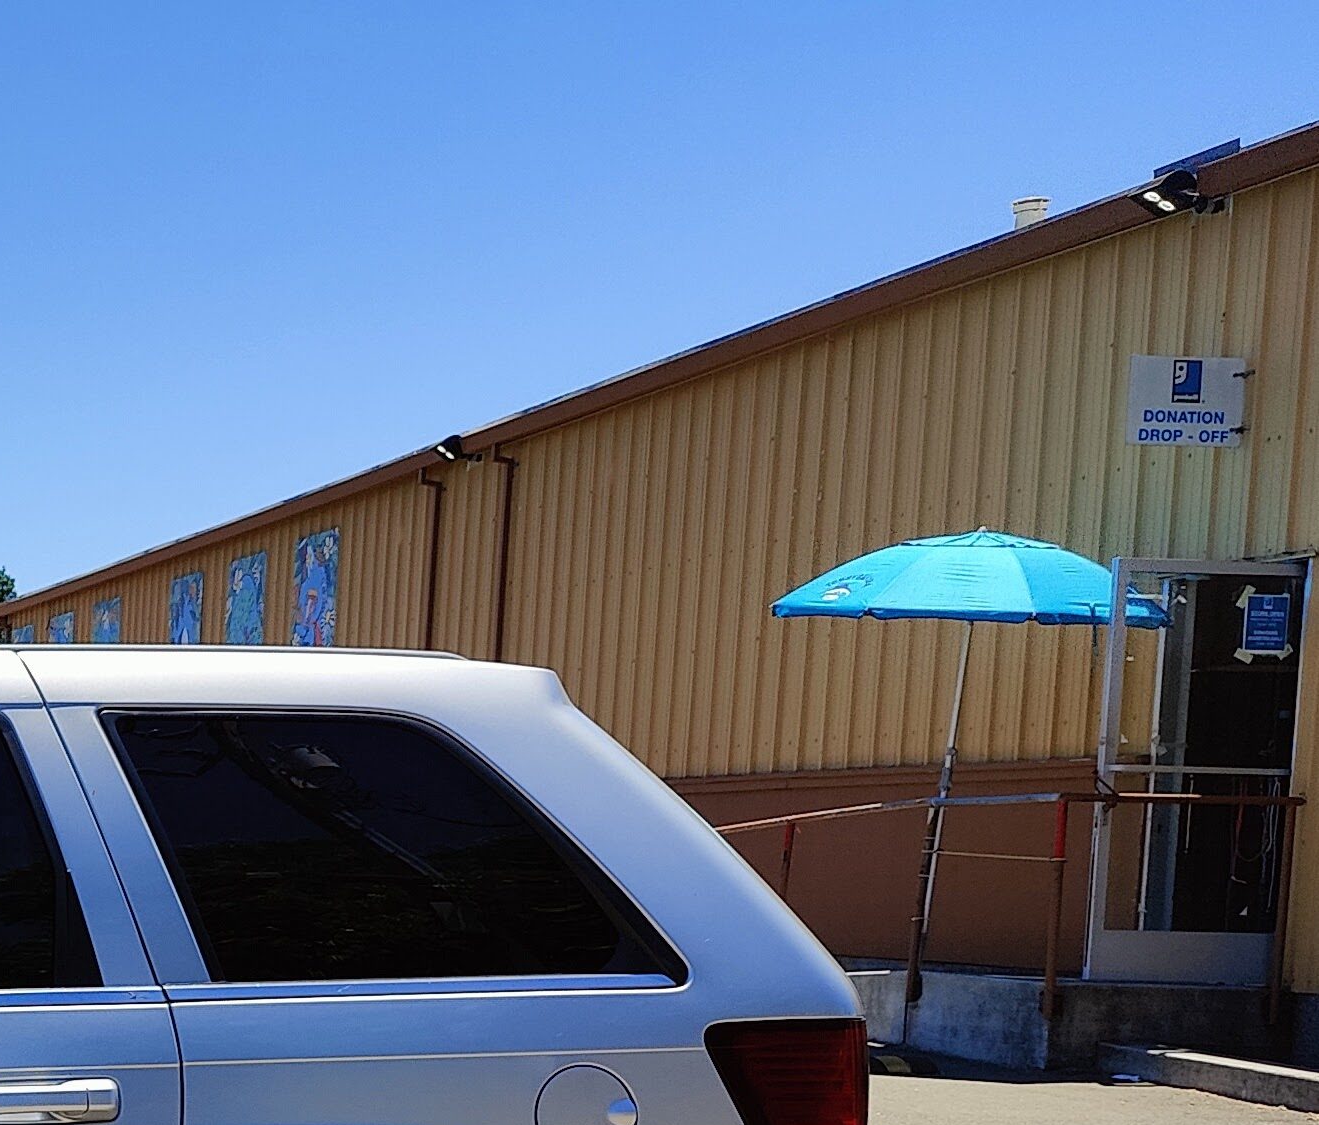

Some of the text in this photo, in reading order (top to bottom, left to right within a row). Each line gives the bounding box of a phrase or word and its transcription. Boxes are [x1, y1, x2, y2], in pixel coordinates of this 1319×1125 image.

[1143, 410, 1225, 424] DONATION
[1138, 428, 1183, 442] DROP
[1198, 430, 1229, 443] OFF
